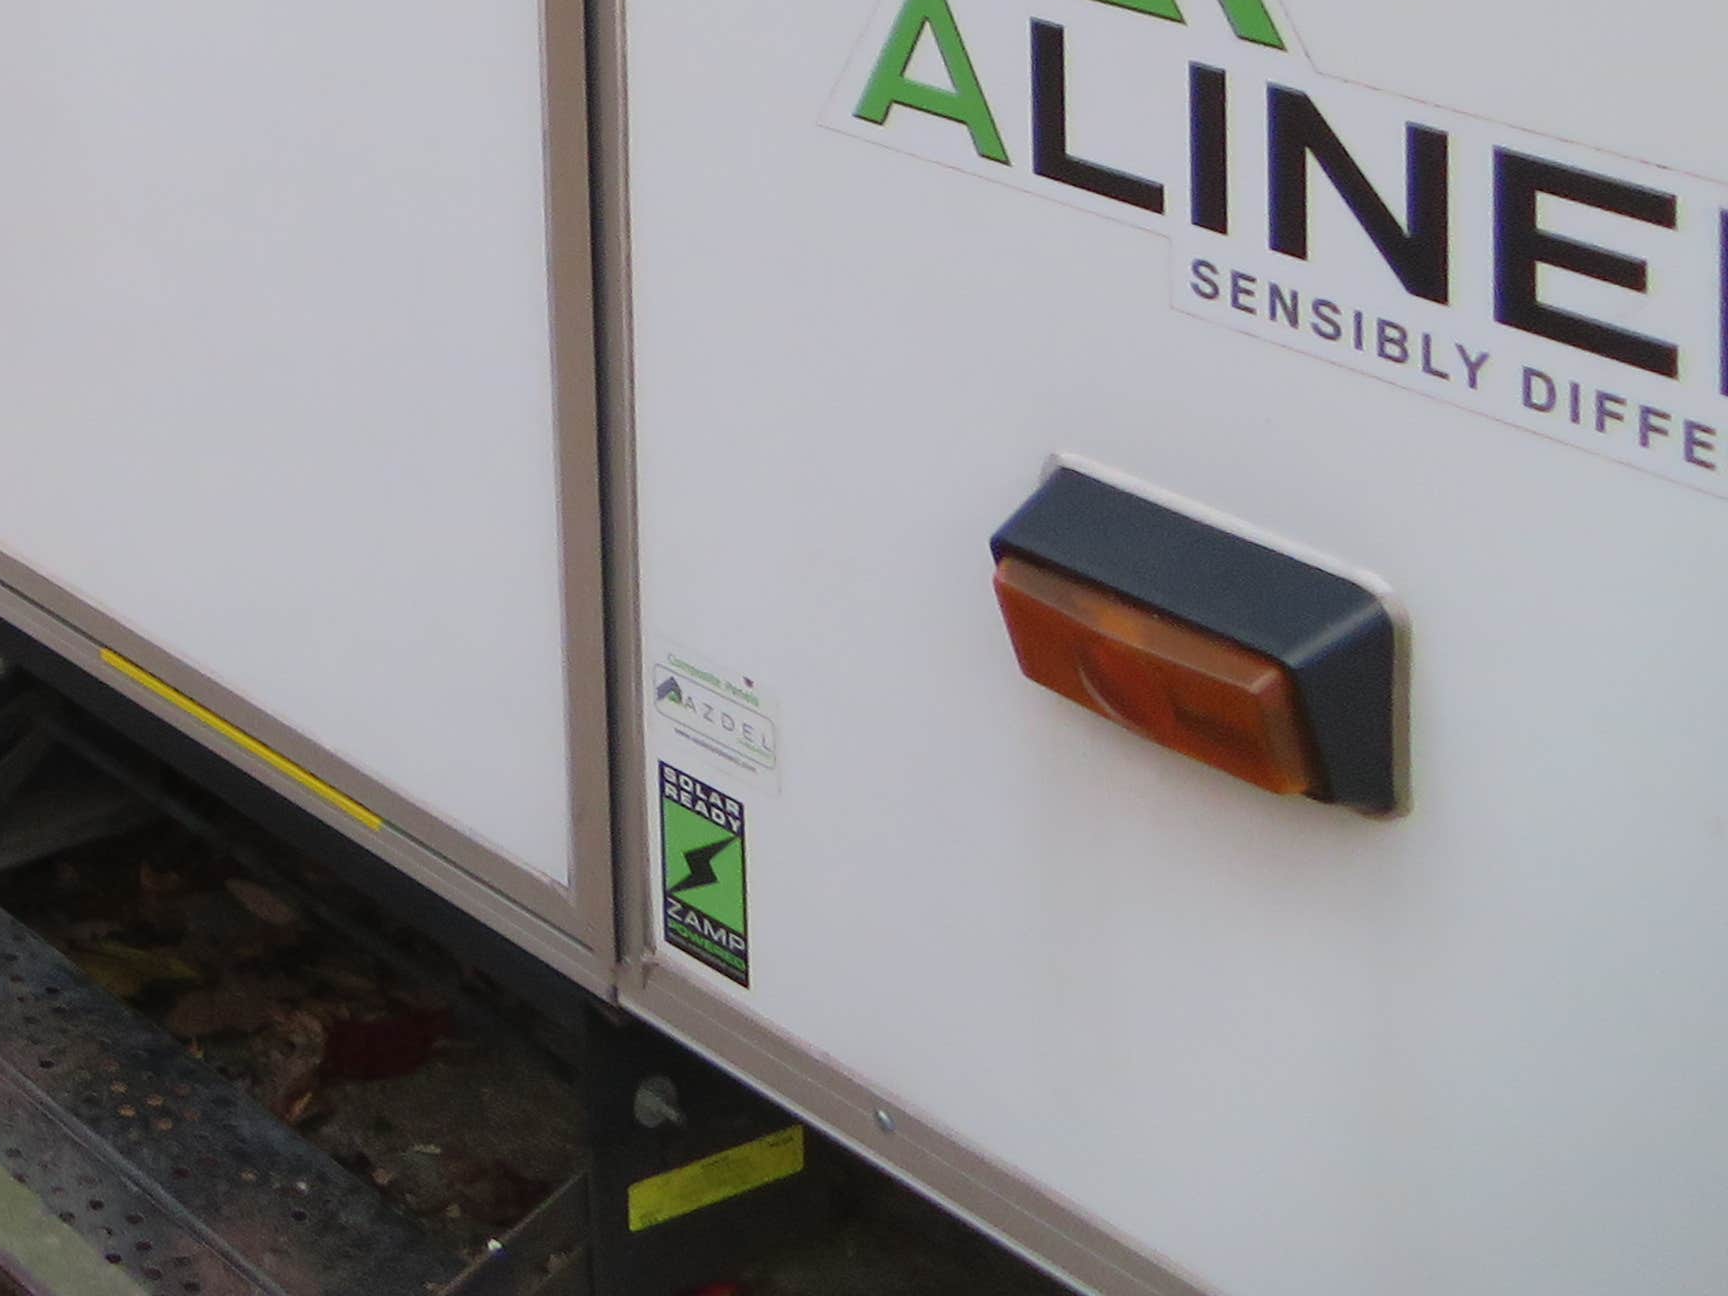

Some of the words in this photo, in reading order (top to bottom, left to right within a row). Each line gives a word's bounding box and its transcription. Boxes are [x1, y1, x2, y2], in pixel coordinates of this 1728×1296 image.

[1190, 258, 1489, 390] SENSIBLY
[1522, 365, 1717, 471] DIFFE
[683, 695, 773, 752] AZDEL
[663, 765, 740, 818] SOLAR
[664, 781, 741, 833] READY
[665, 896, 746, 951] ZAMP
